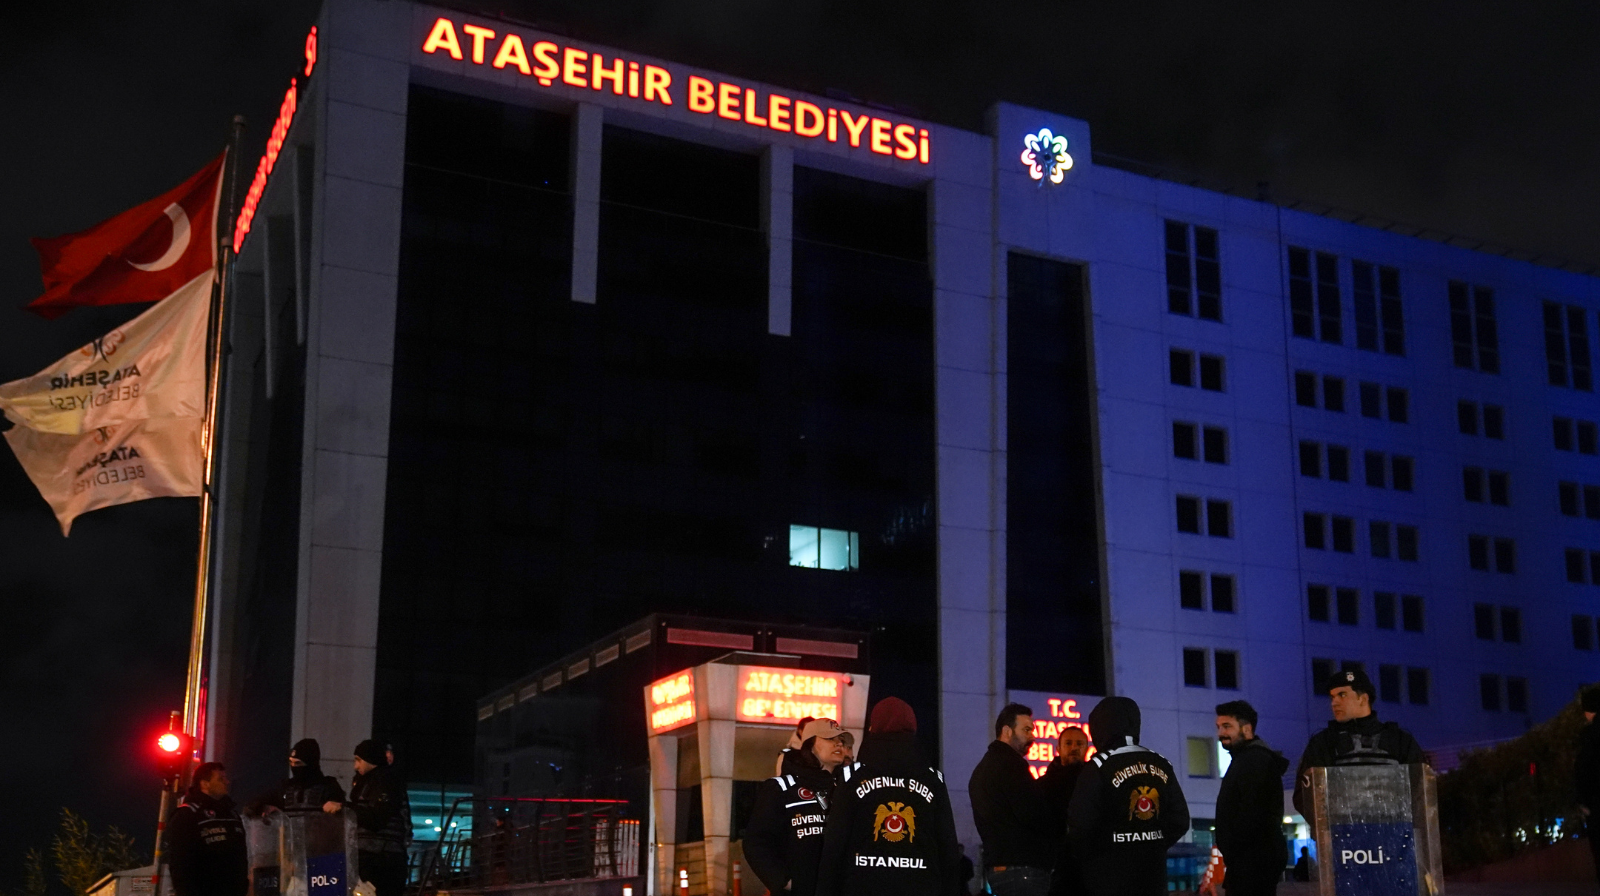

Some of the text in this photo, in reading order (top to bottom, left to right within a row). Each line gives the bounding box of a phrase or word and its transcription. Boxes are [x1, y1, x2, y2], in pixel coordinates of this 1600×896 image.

[1048, 698, 1081, 719] T.C.
[1149, 764, 1169, 784] ŞUBE
[908, 778, 934, 804] ŞUBE
